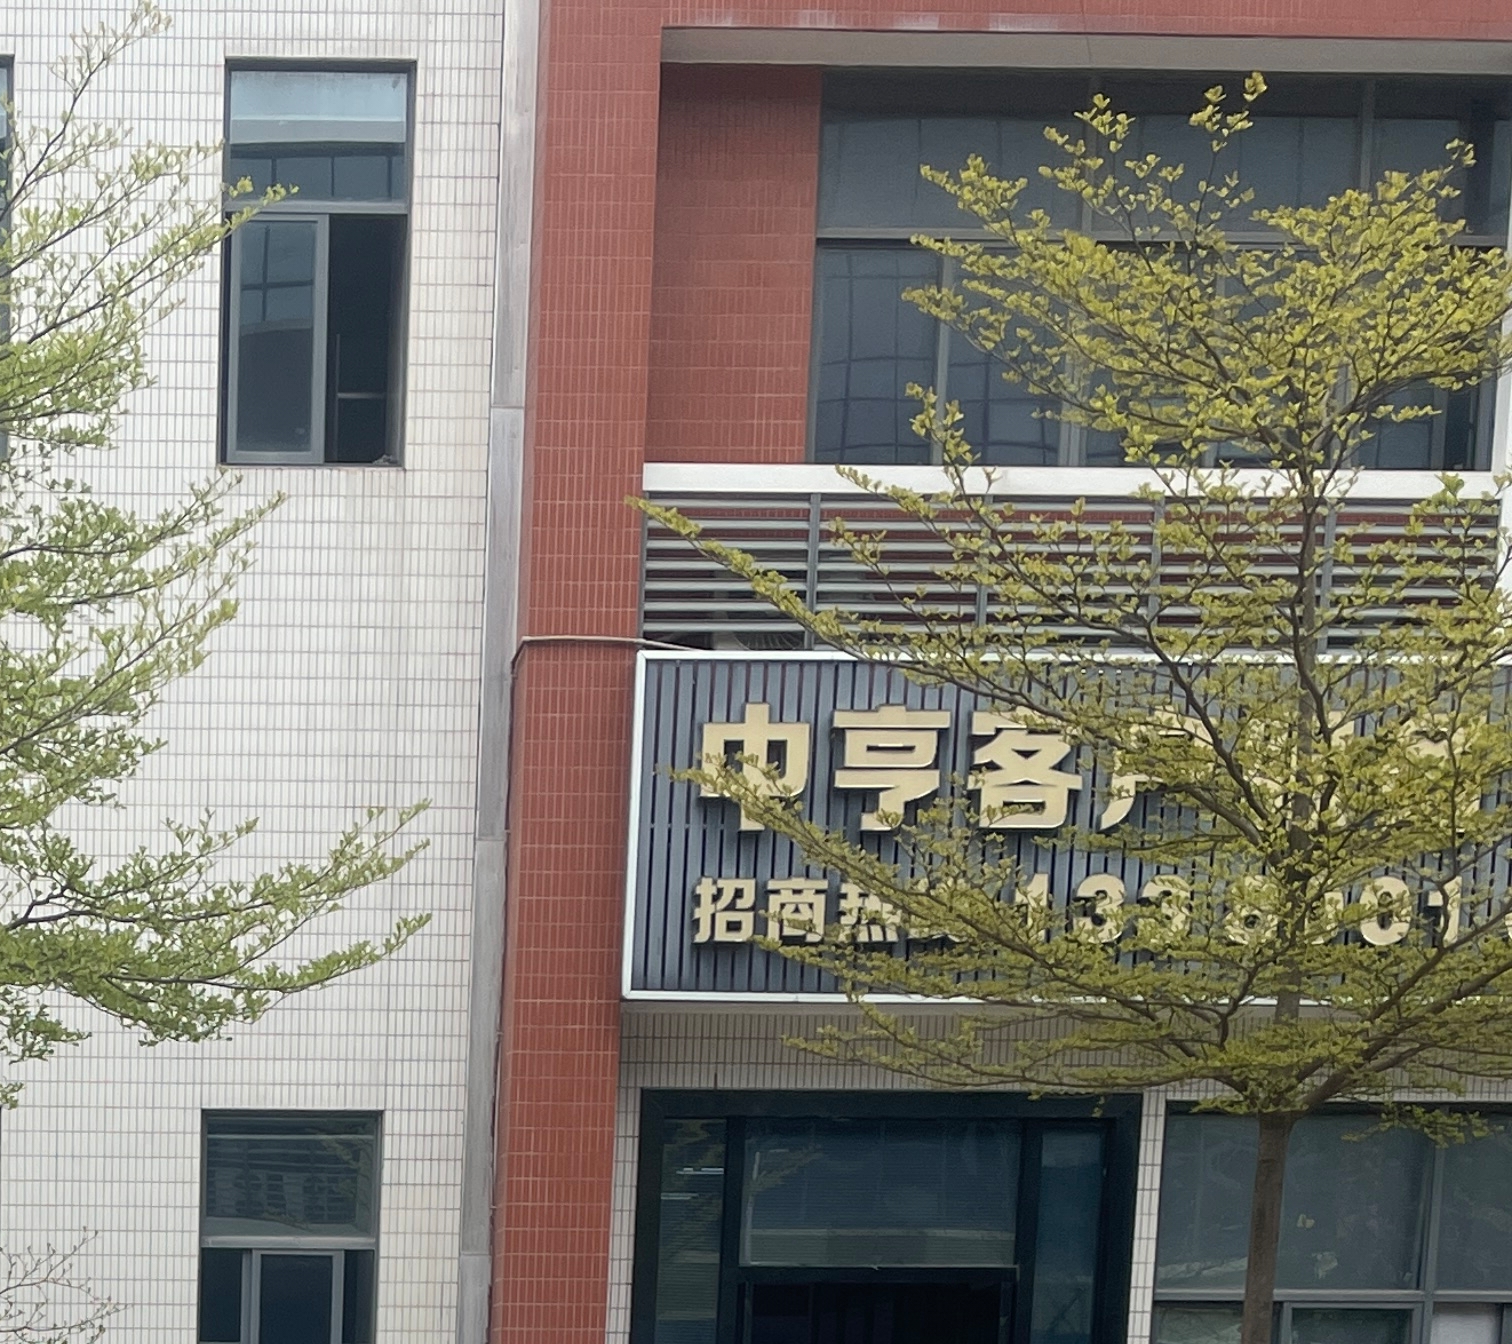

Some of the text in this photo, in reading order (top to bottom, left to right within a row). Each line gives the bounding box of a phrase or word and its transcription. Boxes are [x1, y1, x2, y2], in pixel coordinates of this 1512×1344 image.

[699, 702, 1487, 834] 中亨客
[692, 877, 968, 943] 招商热
